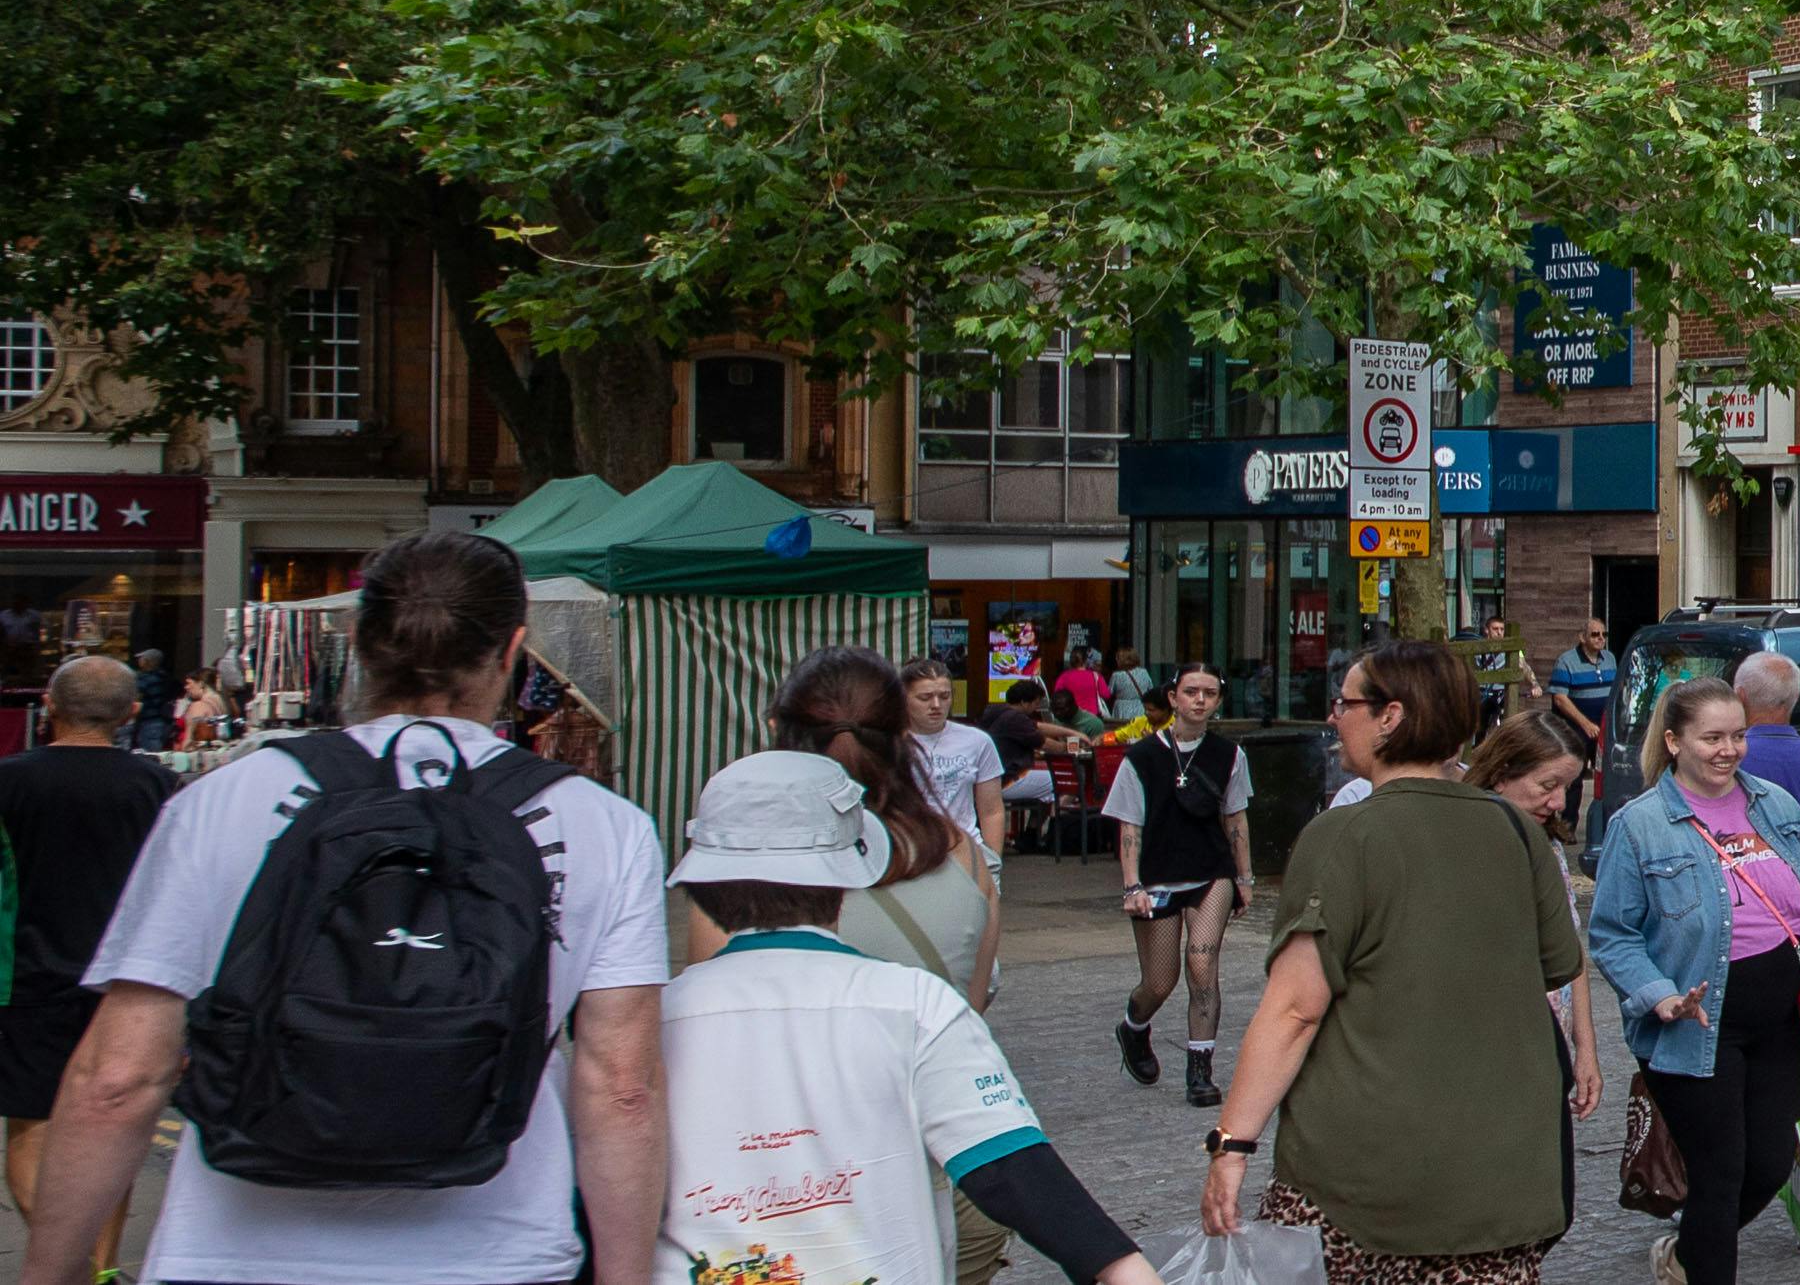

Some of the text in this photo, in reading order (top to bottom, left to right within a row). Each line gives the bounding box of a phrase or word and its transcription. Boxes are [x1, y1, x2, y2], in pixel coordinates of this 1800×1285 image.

[1545, 261, 1600, 281] BUSINESS
[1577, 286, 1593, 299] 1971
[1354, 343, 1428, 359] PEDESTRIAN
[1544, 344, 1561, 362] OR
[1361, 358, 1422, 371] and CYCLE
[1364, 372, 1417, 392] ZONE
[1572, 366, 1595, 384] RRP
[1273, 450, 1349, 490] PAVERS
[1364, 474, 1417, 487] Except for
[1371, 486, 1409, 500] loading
[0, 493, 99, 531] ANGER
[1360, 504, 1367, 514] 4
[1369, 506, 1386, 516] pm
[1393, 504, 1405, 514] 10
[1407, 506, 1422, 515] am
[1389, 525, 1422, 540] At any
[1721, 837, 1755, 854] ALM
